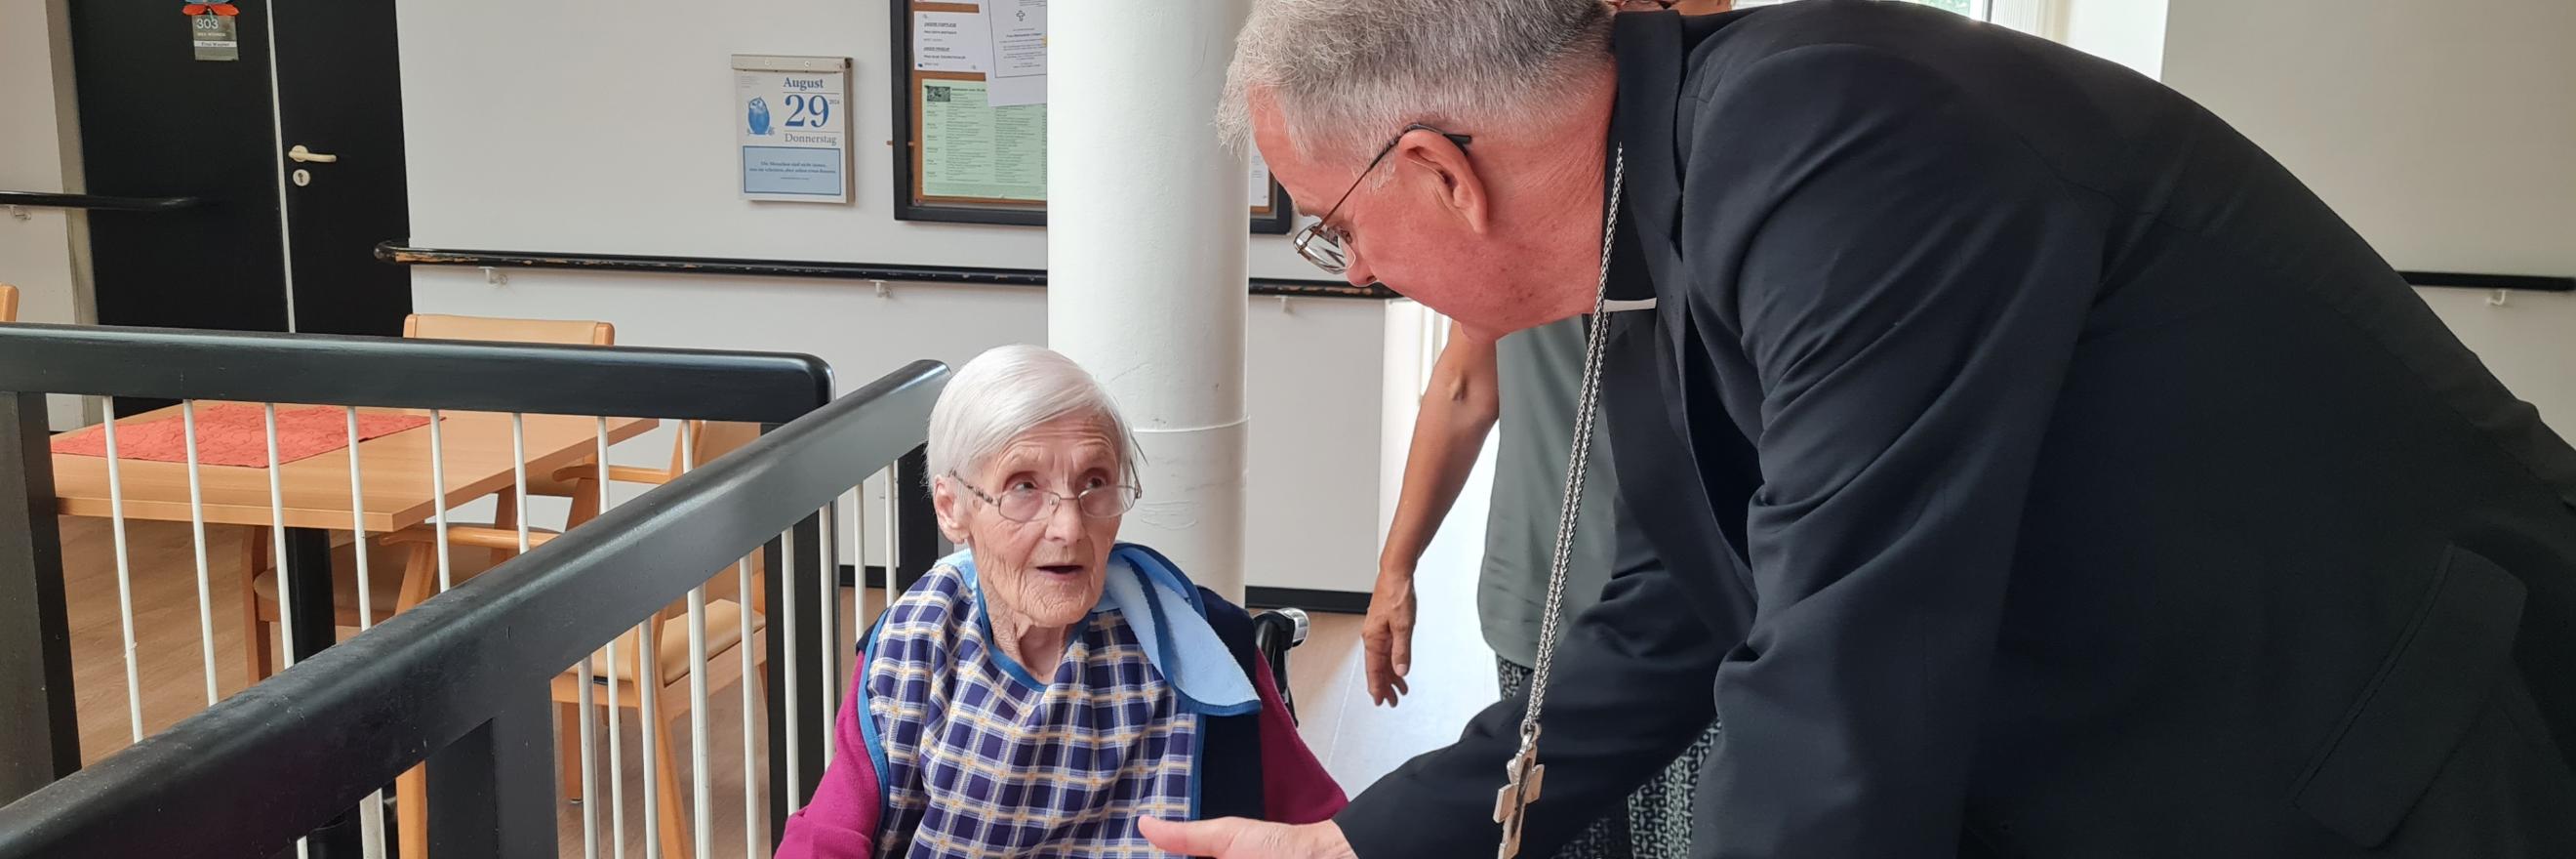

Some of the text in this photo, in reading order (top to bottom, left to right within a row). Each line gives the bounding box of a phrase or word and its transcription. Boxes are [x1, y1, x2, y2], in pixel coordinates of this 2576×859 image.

[196, 18, 219, 29] 303
[784, 77, 824, 91] August
[785, 95, 829, 128] 29
[785, 133, 837, 145] Donnerstag
